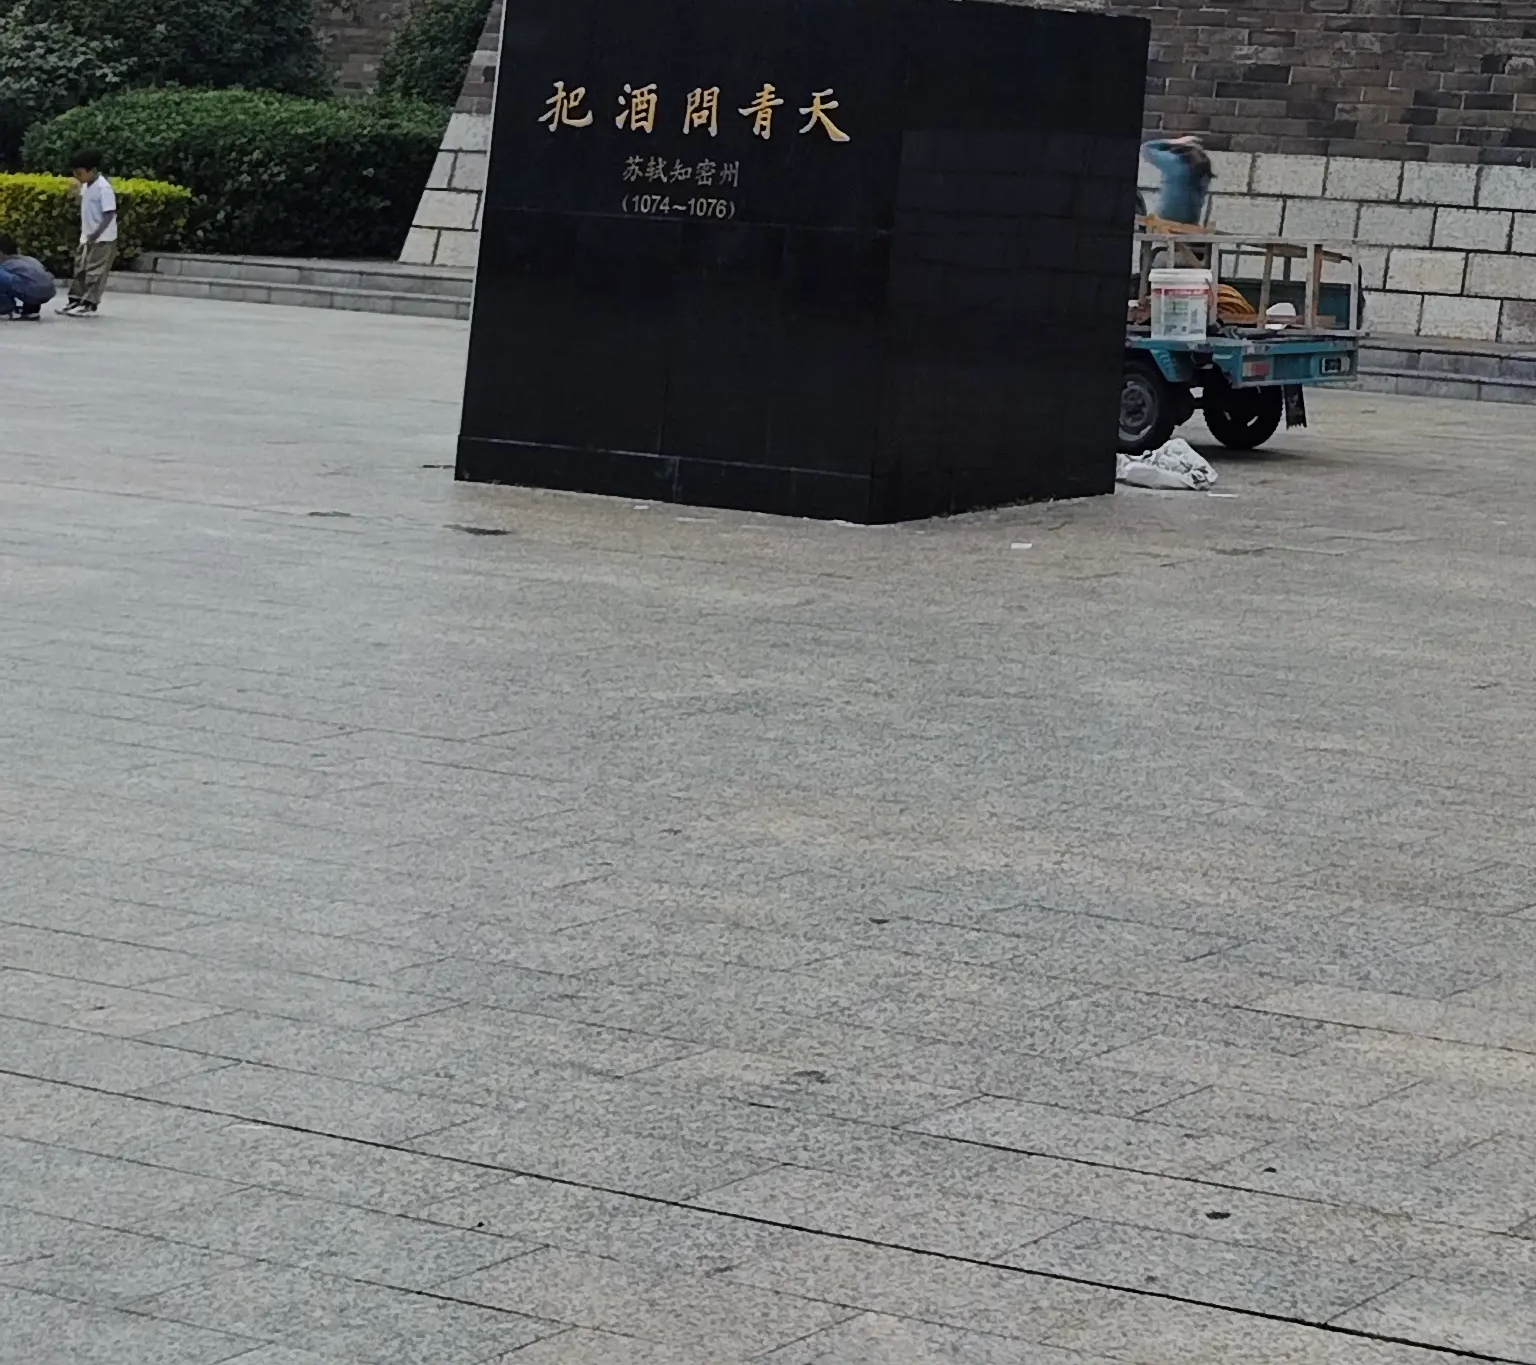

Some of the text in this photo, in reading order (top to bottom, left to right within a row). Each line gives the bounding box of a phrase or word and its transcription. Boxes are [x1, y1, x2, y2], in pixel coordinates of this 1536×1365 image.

[537, 80, 851, 142] 把酒問青天
[621, 154, 740, 188] 苏轼知密州
